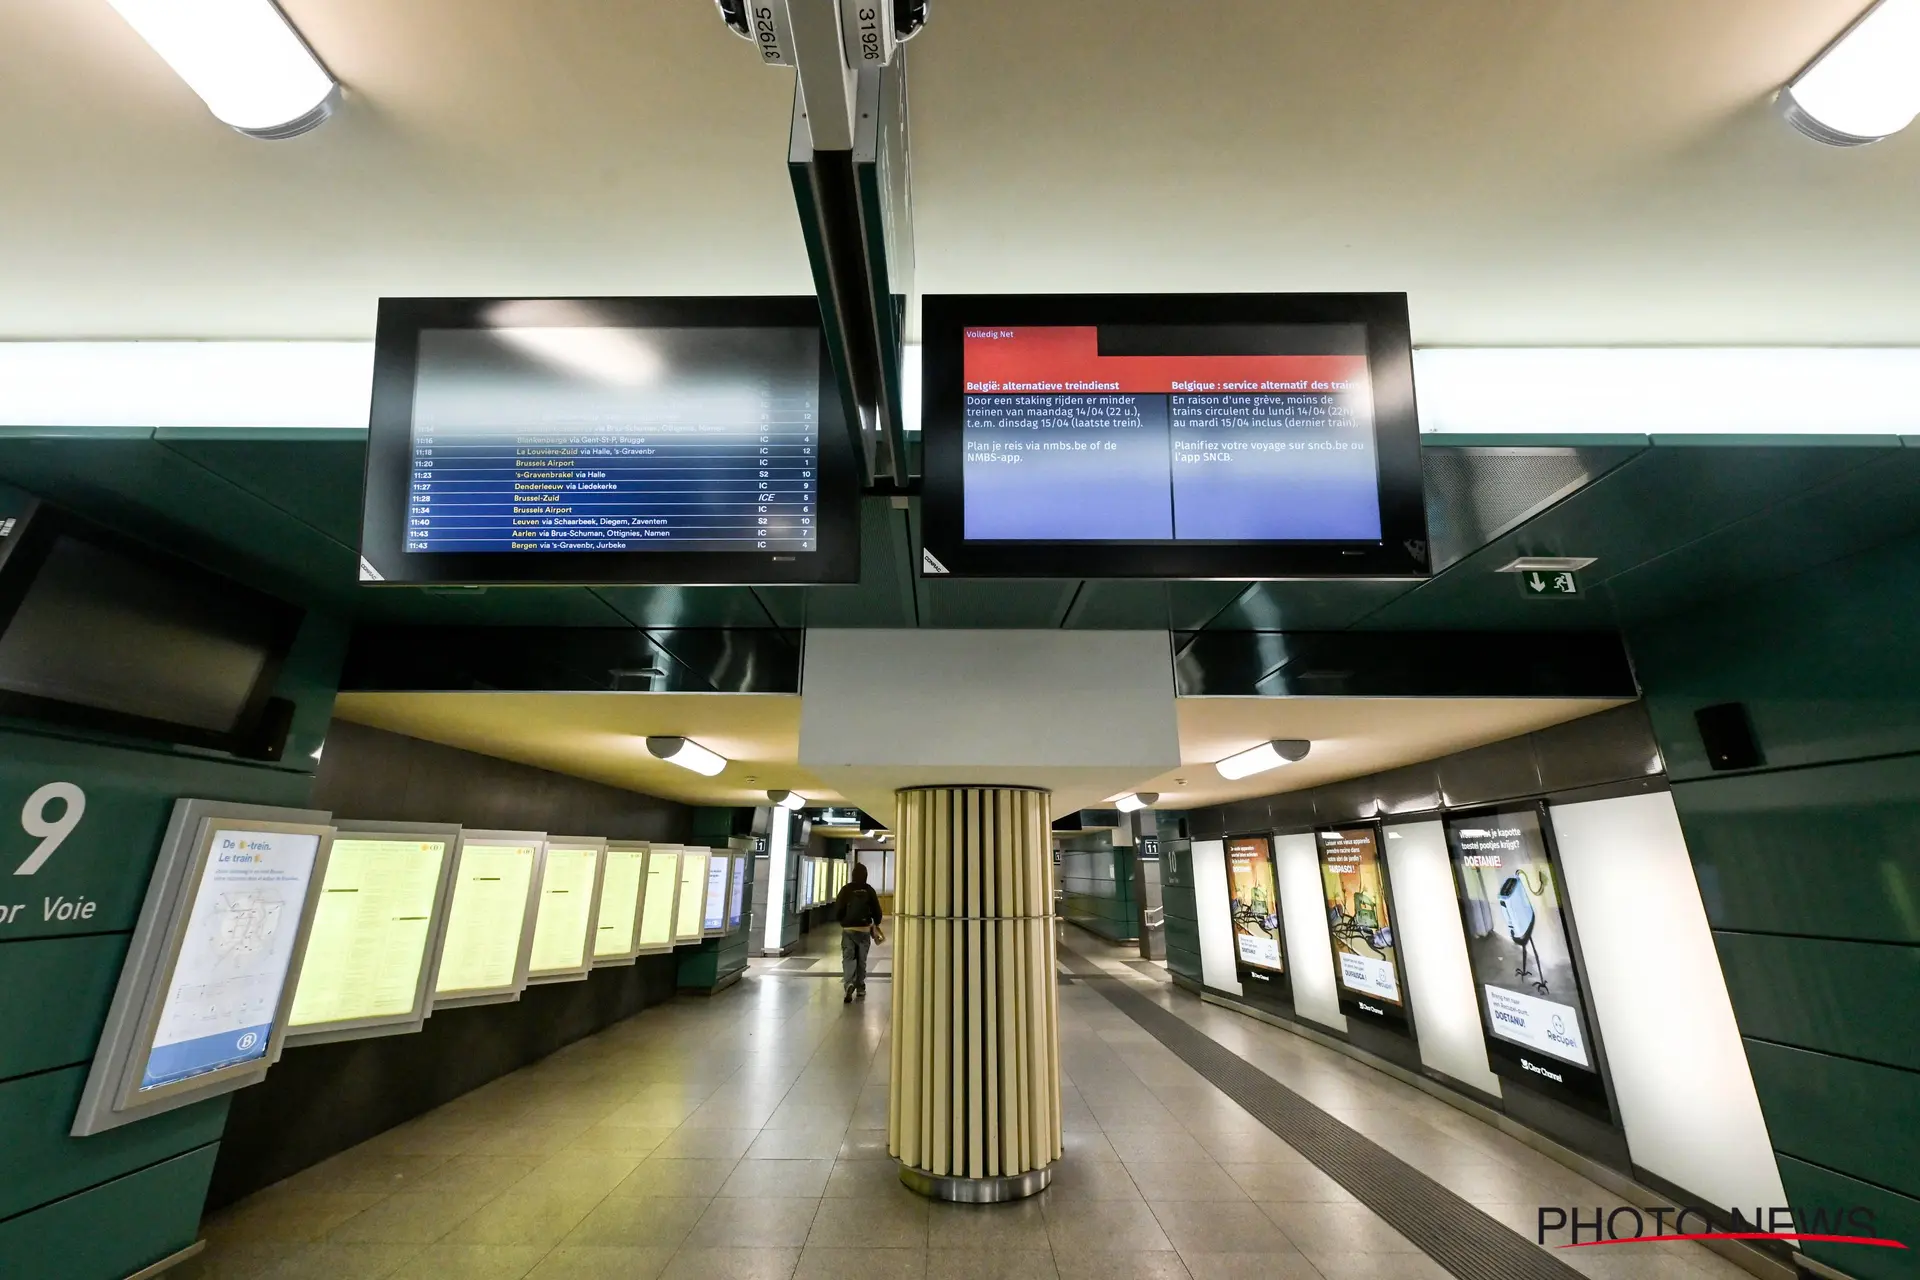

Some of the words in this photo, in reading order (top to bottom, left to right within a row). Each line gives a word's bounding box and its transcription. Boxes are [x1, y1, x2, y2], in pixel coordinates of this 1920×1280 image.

[756, 8, 781, 59] 31925
[859, 9, 879, 60] 31926
[967, 330, 998, 339] Volledig
[966, 381, 1001, 392] België:
[1002, 381, 1063, 391] alternatieve
[1065, 381, 1120, 391] treindienst
[1172, 381, 1215, 391] Belgique
[1223, 382, 1258, 390] service
[1261, 381, 1308, 390] alternatif
[1311, 381, 1329, 390] des
[967, 397, 991, 405] Door
[1016, 396, 1052, 407] staking
[1055, 396, 1083, 407] rijden
[1100, 397, 1136, 405] minder
[1173, 396, 1185, 404] En
[1188, 396, 1219, 404] raison
[1222, 395, 1251, 404] d'une
[1254, 395, 1284, 406] grève,
[1287, 396, 1318, 404] moins
[1321, 396, 1333, 404] de
[967, 408, 1003, 417] treinen
[1006, 409, 1024, 417] van
[1027, 408, 1074, 418] maandag
[1076, 408, 1104, 417] 14/04
[1106, 408, 1121, 418] (22
[1124, 408, 1141, 418] u.),
[1173, 407, 1202, 416] trains
[1205, 407, 1249, 416] circulent
[1252, 407, 1265, 416] du
[1268, 407, 1294, 416] lundi
[1298, 407, 1325, 416] 14/04
[967, 419, 996, 428] t.e.m.
[998, 419, 1039, 430] dinsdag
[1041, 419, 1069, 428] 15/04
[1072, 419, 1110, 429] (laatste
[1113, 419, 1144, 429] trein).
[1189, 419, 1218, 427] mardi
[1221, 419, 1249, 428] 15/04
[1252, 418, 1282, 427] inclus
[1285, 418, 1325, 428] (dernier
[620, 437, 645, 445] Brugge
[968, 442, 989, 450] Plan
[992, 442, 1001, 452] je
[1005, 442, 1023, 450] reis
[1026, 442, 1040, 450] via
[1043, 441, 1087, 450] nmbs.be
[1090, 441, 1101, 450] of
[1104, 442, 1117, 450] de
[1175, 441, 1219, 450] Planifiez
[1222, 442, 1248, 450] votre
[1251, 443, 1286, 452] voyage
[1308, 441, 1348, 450] sncb.be
[968, 453, 1023, 464] NMBS-app.
[1175, 453, 1200, 463] l'app
[1203, 453, 1233, 461] SNCB.
[548, 460, 575, 468] Airport
[554, 518, 598, 526] Schaarbeek,
[600, 518, 630, 526] Diegem,
[551, 530, 605, 538] Brus-Schuman,
[607, 530, 643, 538] Ottignies,
[512, 542, 538, 550] Bergen
[13, 782, 87, 876] 9
[1498, 828, 1521, 838] kapotte
[223, 840, 235, 849] De
[1148, 845, 1157, 853] 11
[1480, 841, 1500, 851] pootjes
[1501, 840, 1520, 851] krijgt?
[219, 853, 231, 863] Le
[233, 854, 253, 863] train
[44, 896, 96, 922] Voie
